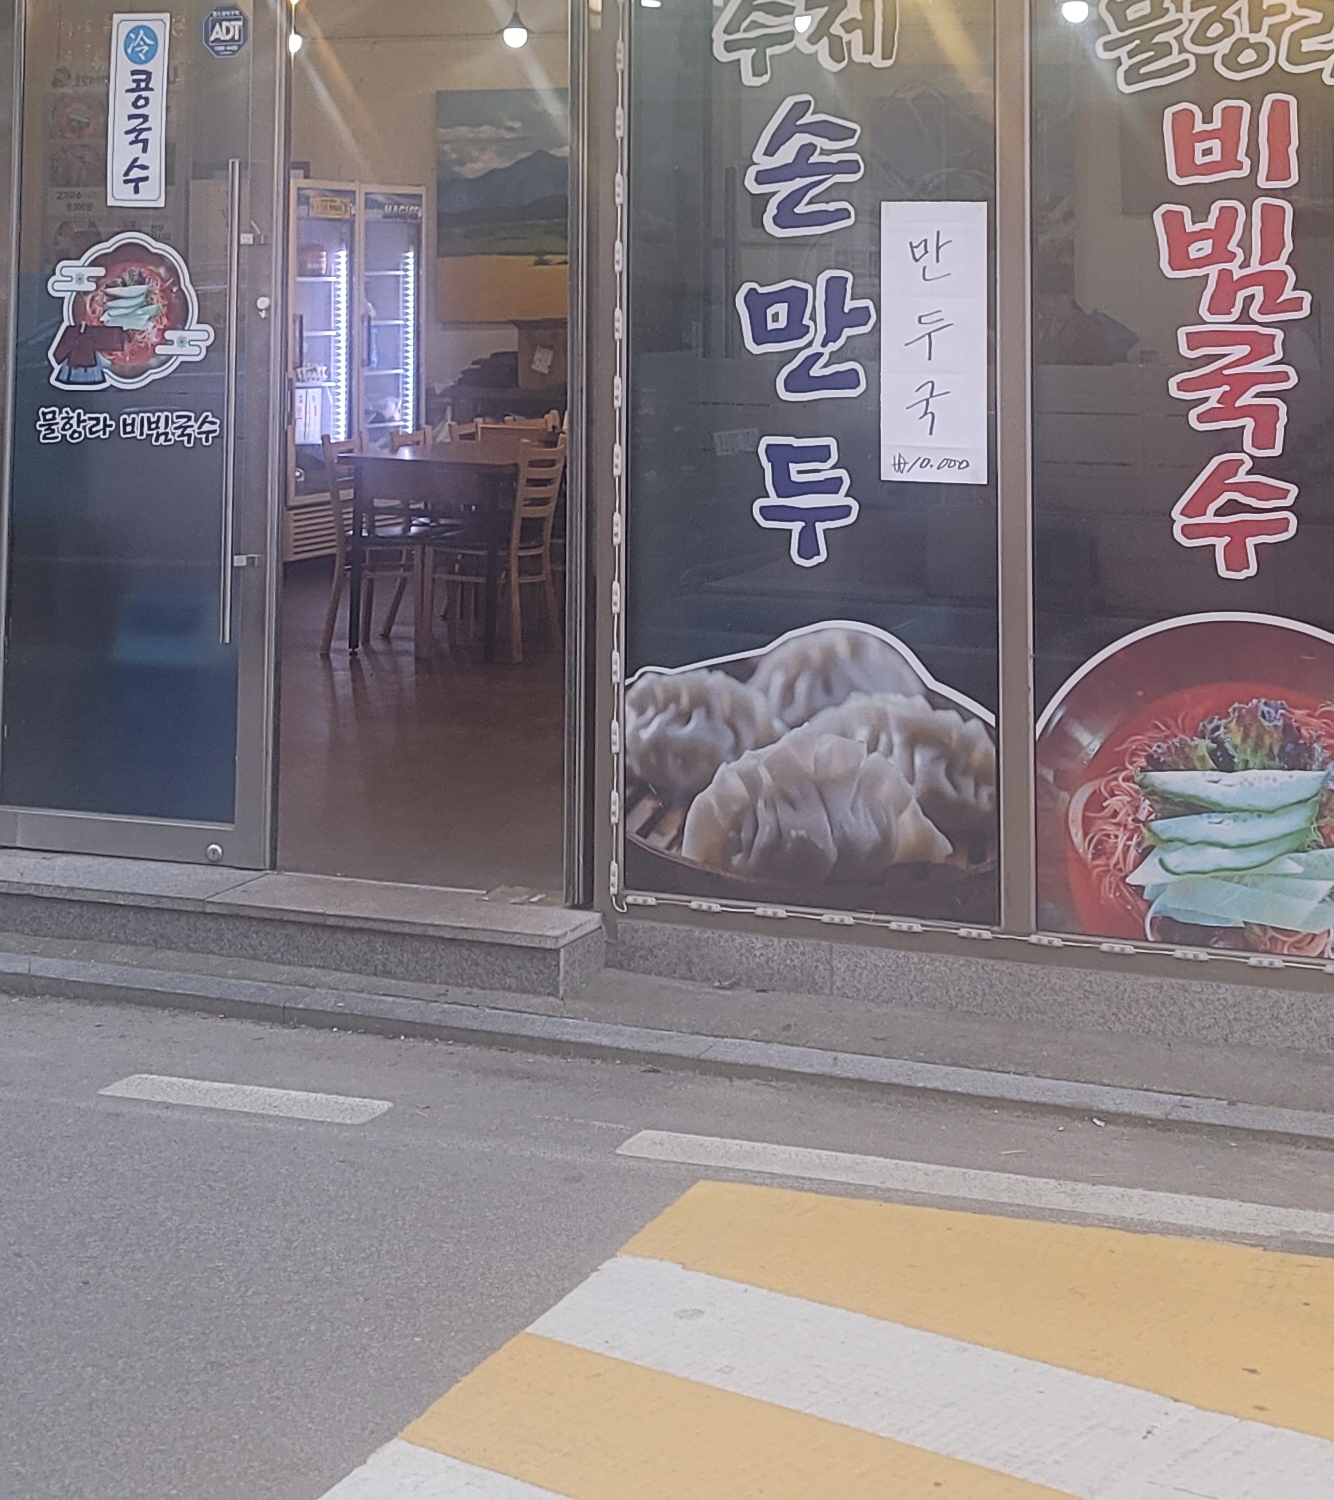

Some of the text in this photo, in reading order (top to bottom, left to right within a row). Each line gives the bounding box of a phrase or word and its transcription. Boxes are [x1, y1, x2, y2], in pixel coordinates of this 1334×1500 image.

[127, 29, 154, 60] 冷
[210, 21, 243, 41] ADT
[122, 69, 154, 194] 콩국수
[736, 95, 876, 566] 손만두
[904, 231, 953, 436] 만두국
[1154, 93, 1312, 579] 비빔국수
[36, 407, 220, 447] 물항라 비빔국수
